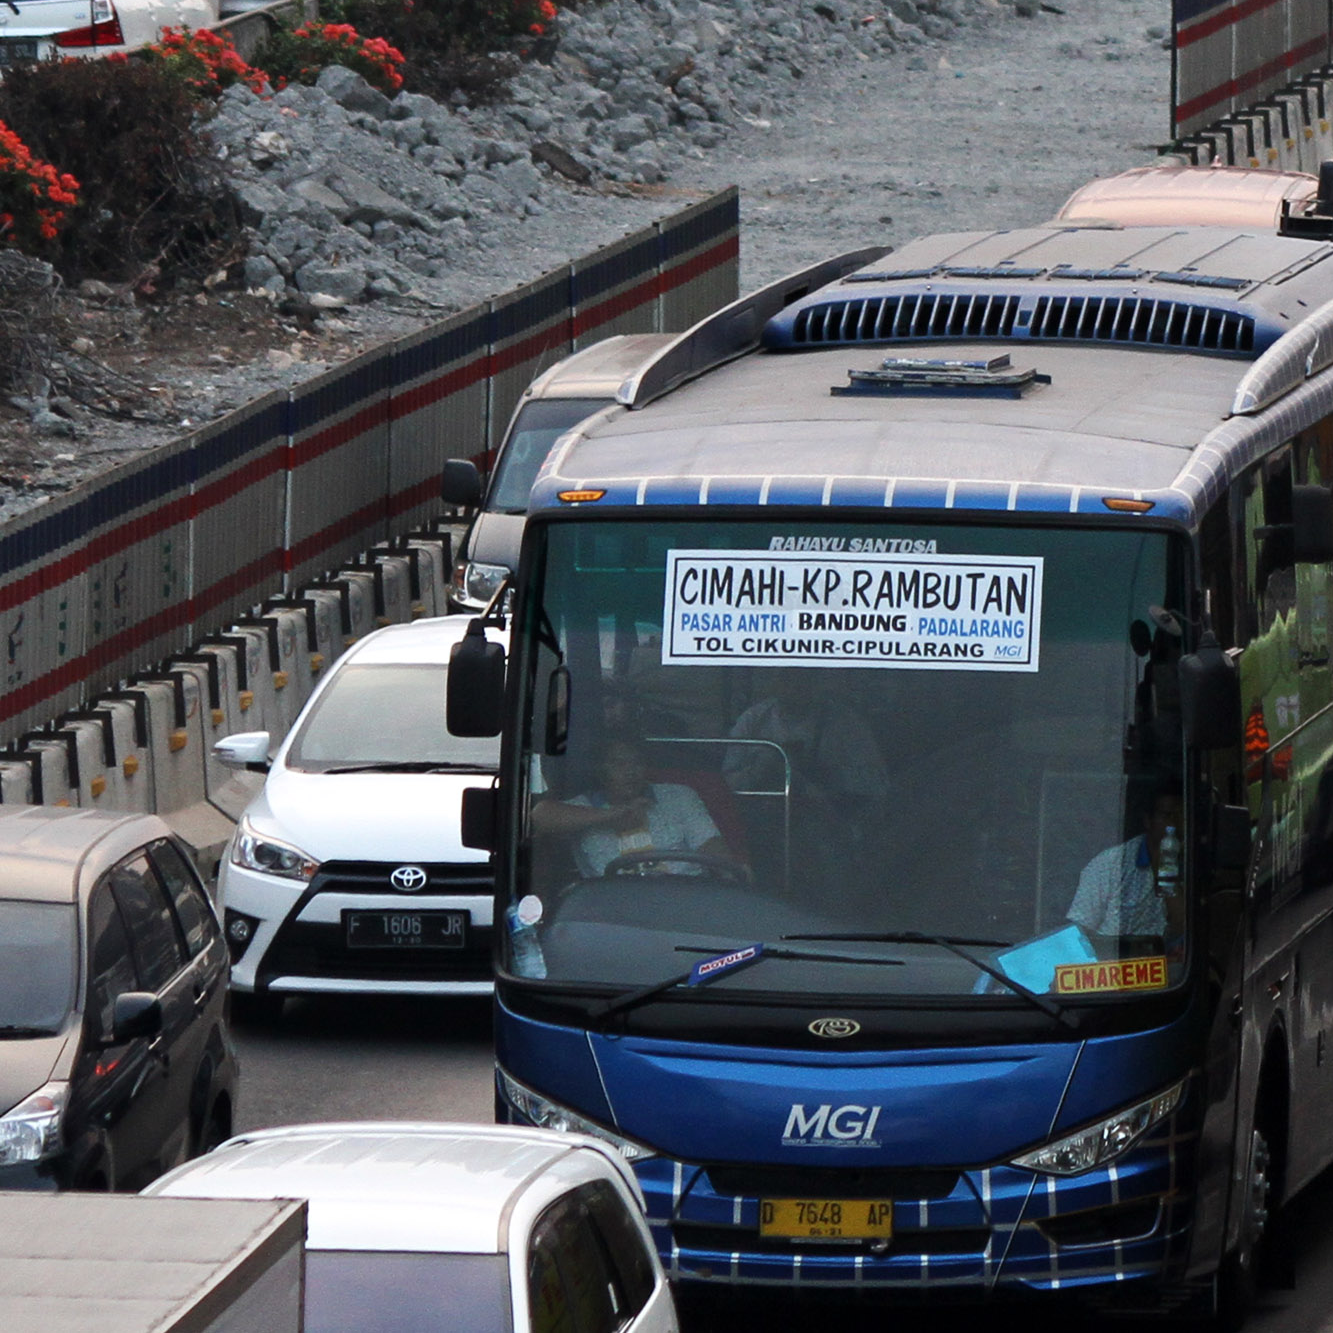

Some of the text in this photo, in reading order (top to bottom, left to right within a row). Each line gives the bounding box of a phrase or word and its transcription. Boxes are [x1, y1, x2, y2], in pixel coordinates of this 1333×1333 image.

[769, 535, 938, 554] RAHAYU SANTOSA
[680, 566, 1028, 616] CIMAHI-KP.RAMBUTAN
[681, 611, 1025, 639] PASAR ANTRI BANDUNG PADALARANG
[693, 636, 1022, 658] TOL CIKUNIR-CIPULARANG MGI
[382, 915, 421, 935] 1606
[441, 915, 461, 935] JR
[700, 949, 742, 975] MOTUL
[1058, 958, 1164, 993] CIMAREME
[782, 1104, 882, 1140] MGI
[762, 1201, 890, 1226] D 7648 AP
